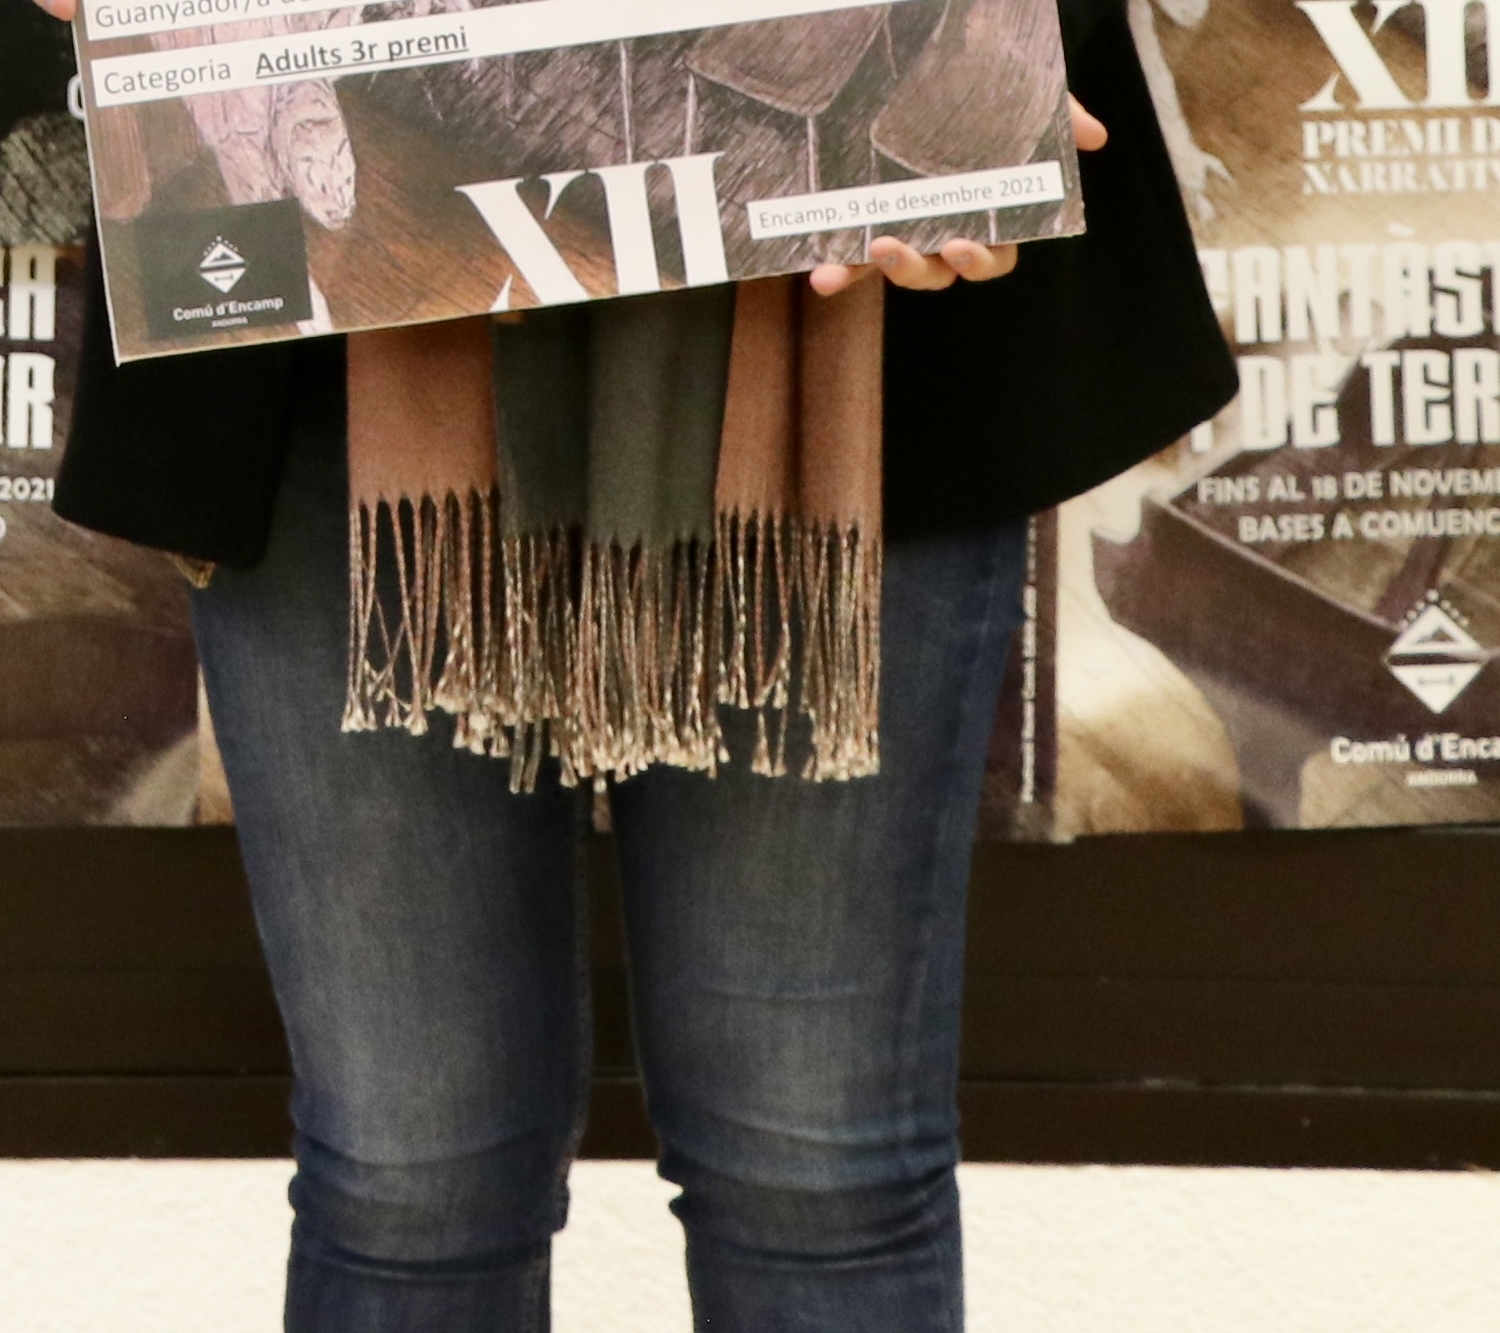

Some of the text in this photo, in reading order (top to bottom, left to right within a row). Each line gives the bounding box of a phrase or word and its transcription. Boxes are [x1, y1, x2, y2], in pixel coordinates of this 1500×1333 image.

[103, 25, 468, 94] Categoria Adults 3r premi
[456, 151, 727, 310] XII
[758, 175, 1045, 229] Encamp, 9 de desembre 2021
[172, 297, 284, 321] Comú d'Encamp
[1238, 353, 1340, 450] DE
[1329, 733, 1409, 762] Comú
